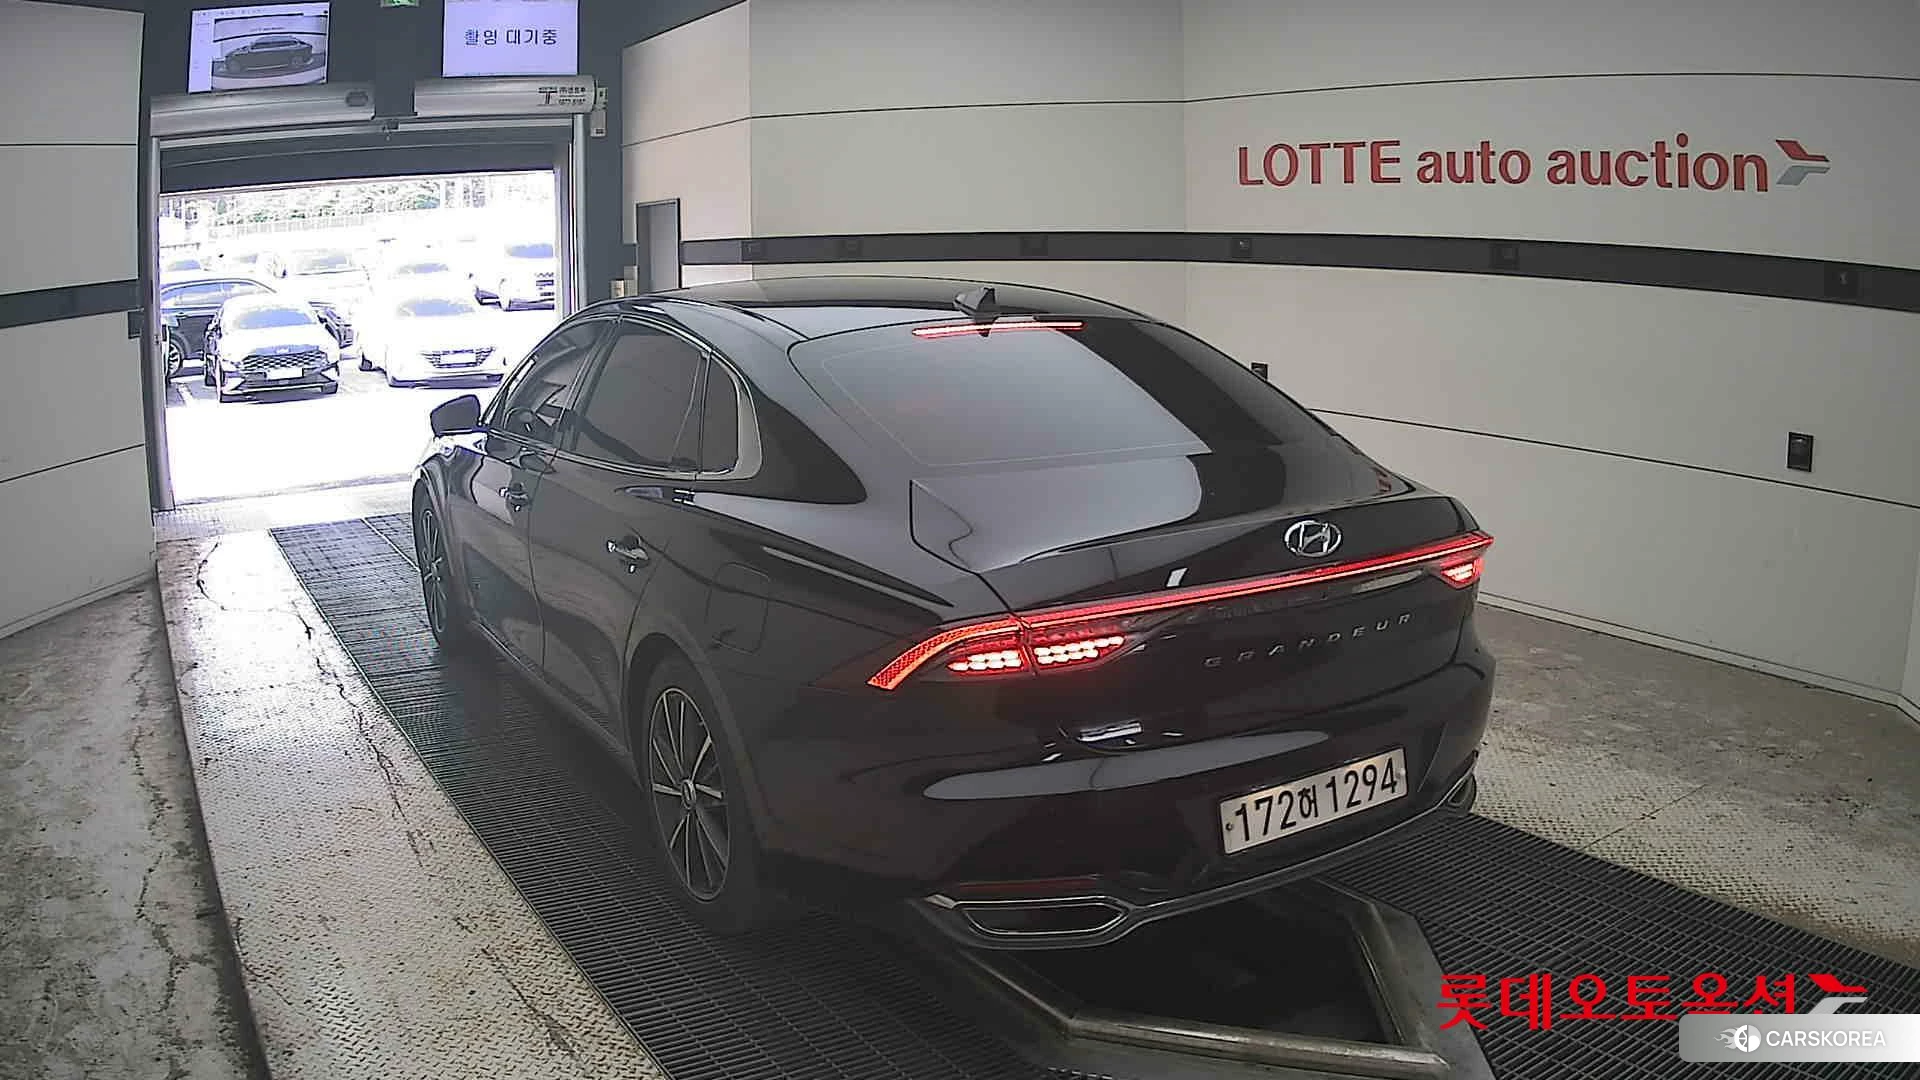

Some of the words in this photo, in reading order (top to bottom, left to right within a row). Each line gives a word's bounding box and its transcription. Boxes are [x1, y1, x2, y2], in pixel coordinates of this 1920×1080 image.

[506, 28, 558, 46] 대기중
[1238, 140, 1401, 187] LOTTE
[1416, 140, 1531, 186] auto
[1546, 132, 1770, 193] auction
[1204, 613, 1412, 667] GRANDEUR
[1325, 756, 1399, 814] 1294
